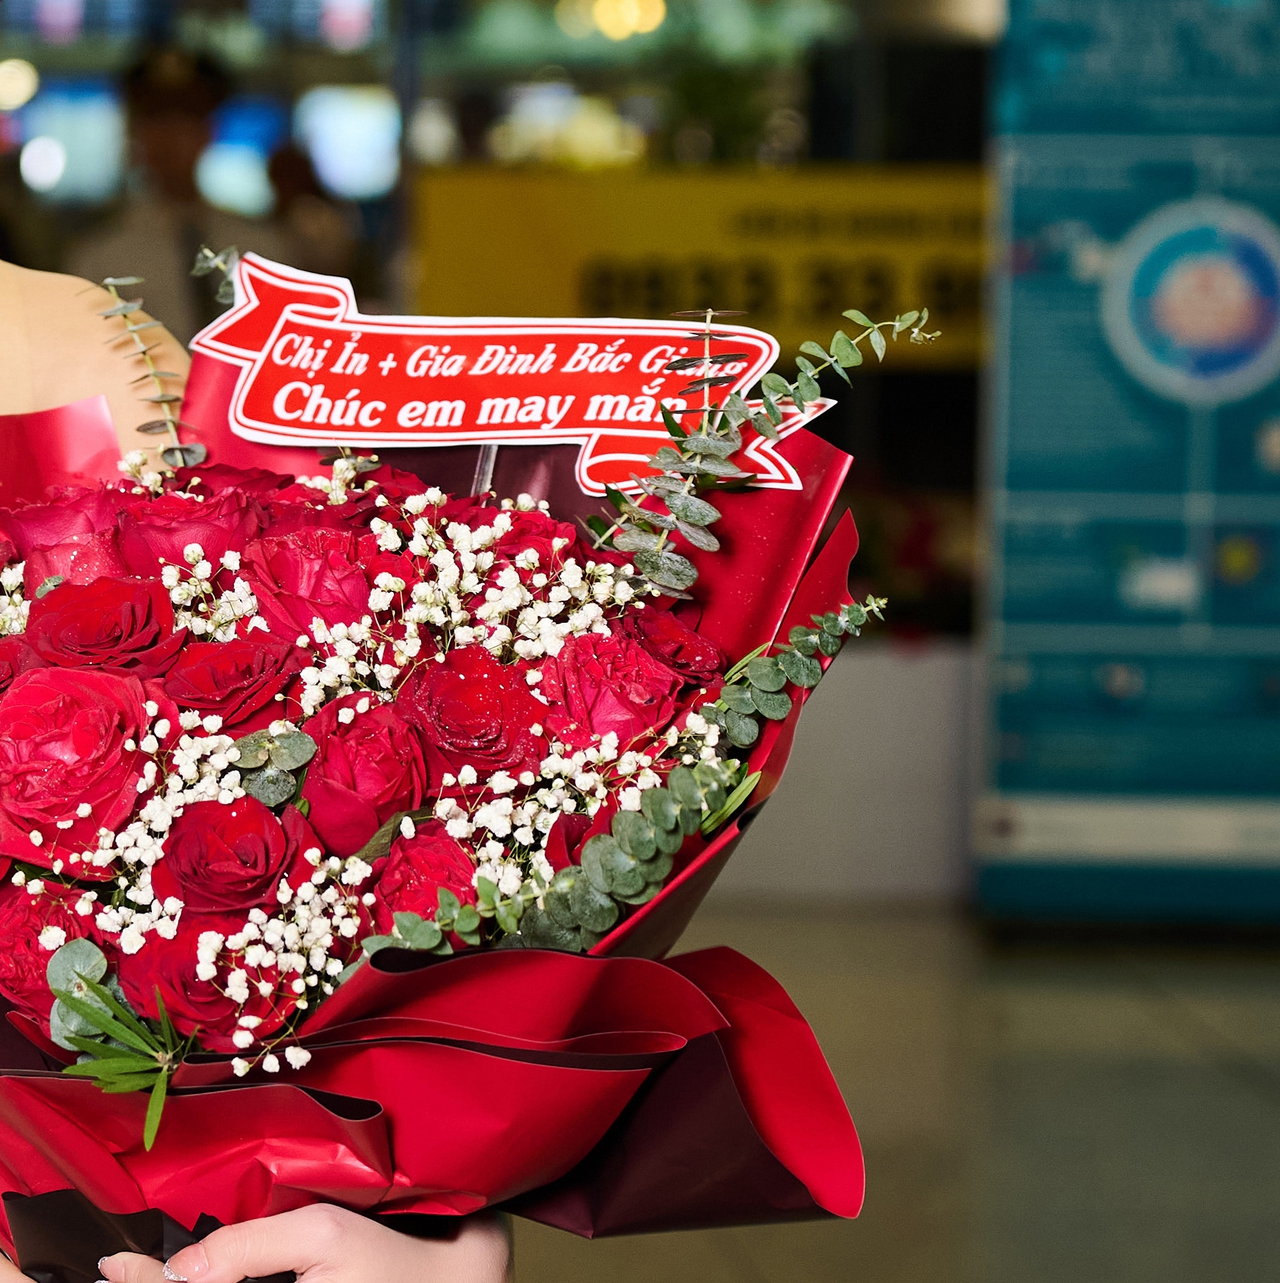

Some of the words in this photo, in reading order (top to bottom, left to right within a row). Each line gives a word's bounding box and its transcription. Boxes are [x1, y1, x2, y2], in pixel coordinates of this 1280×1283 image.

[271, 332, 333, 379] Chị
[378, 352, 398, 377] +
[405, 344, 468, 378] Gia
[468, 343, 558, 376] Đình
[560, 338, 633, 374] Bắc
[272, 380, 387, 428] Chúc
[396, 399, 466, 428] em
[475, 394, 576, 431] may
[583, 377, 688, 424] mắn
